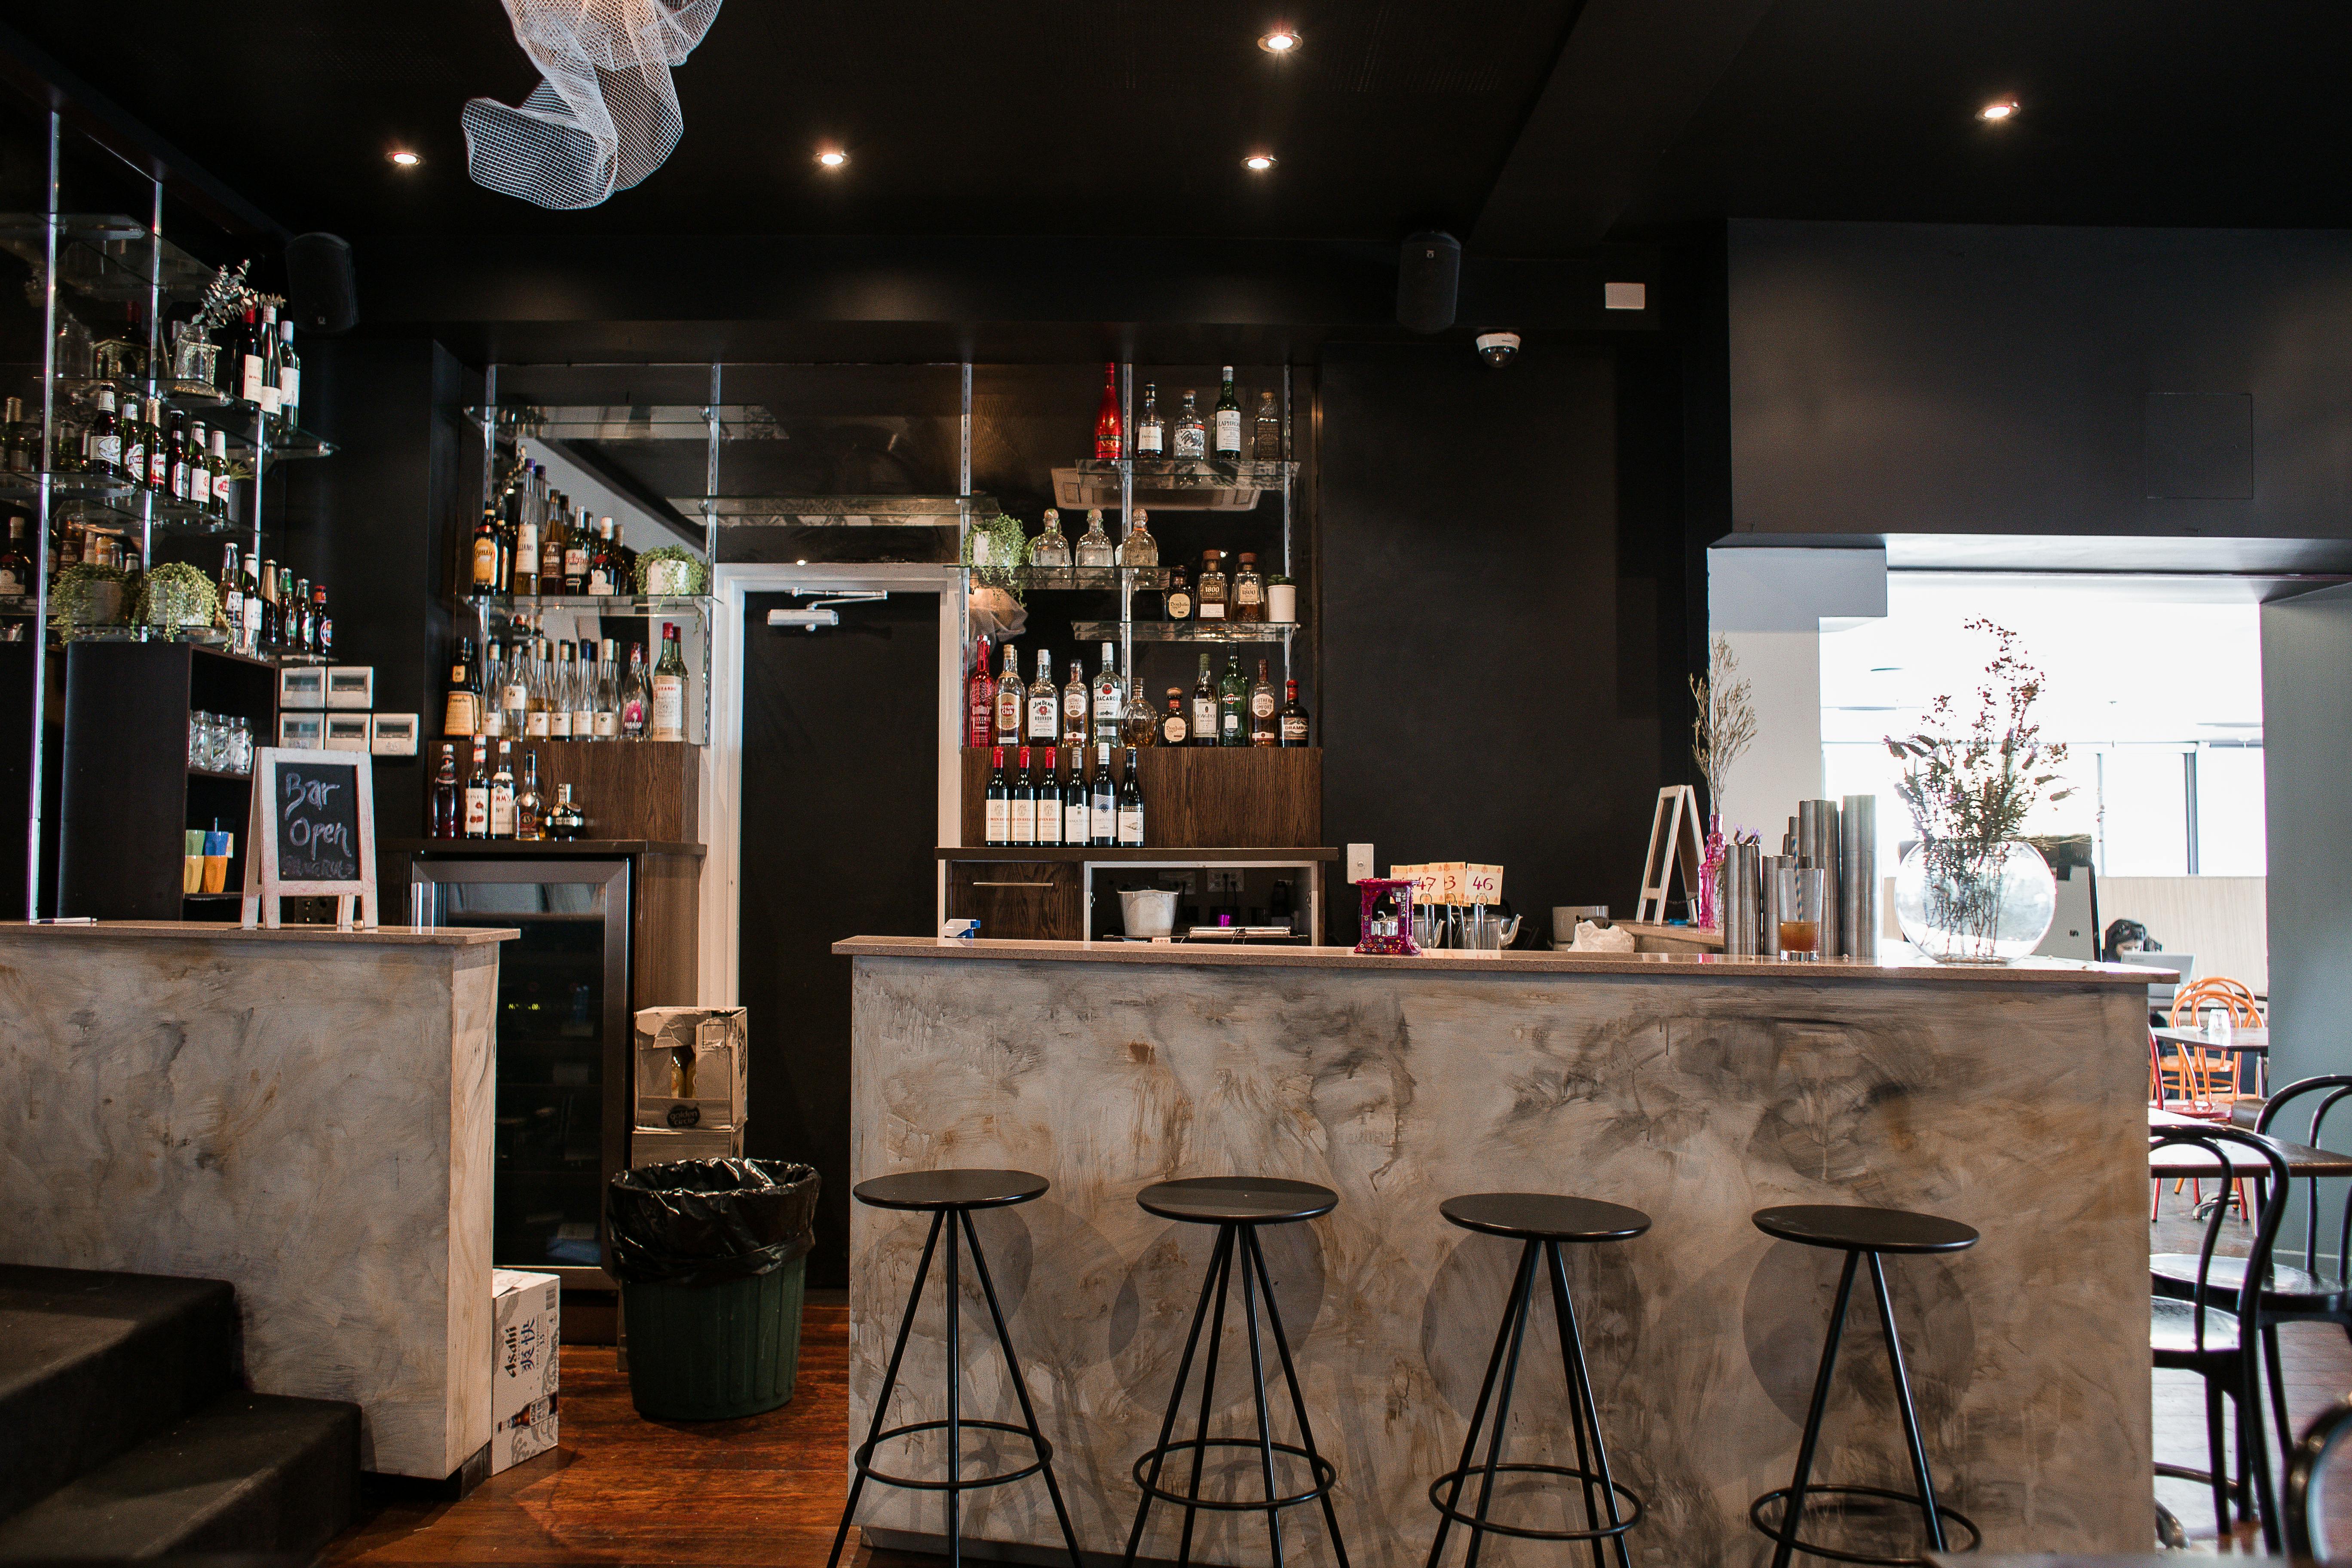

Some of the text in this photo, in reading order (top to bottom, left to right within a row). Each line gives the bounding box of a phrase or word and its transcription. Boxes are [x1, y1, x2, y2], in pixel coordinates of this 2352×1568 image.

[1042, 700, 1053, 708] BEAM
[284, 772, 340, 821] Bar
[290, 817, 352, 861] Open
[1417, 876, 1436, 892] 47
[1473, 876, 1494, 891] 46
[504, 1326, 517, 1378] Asahi
